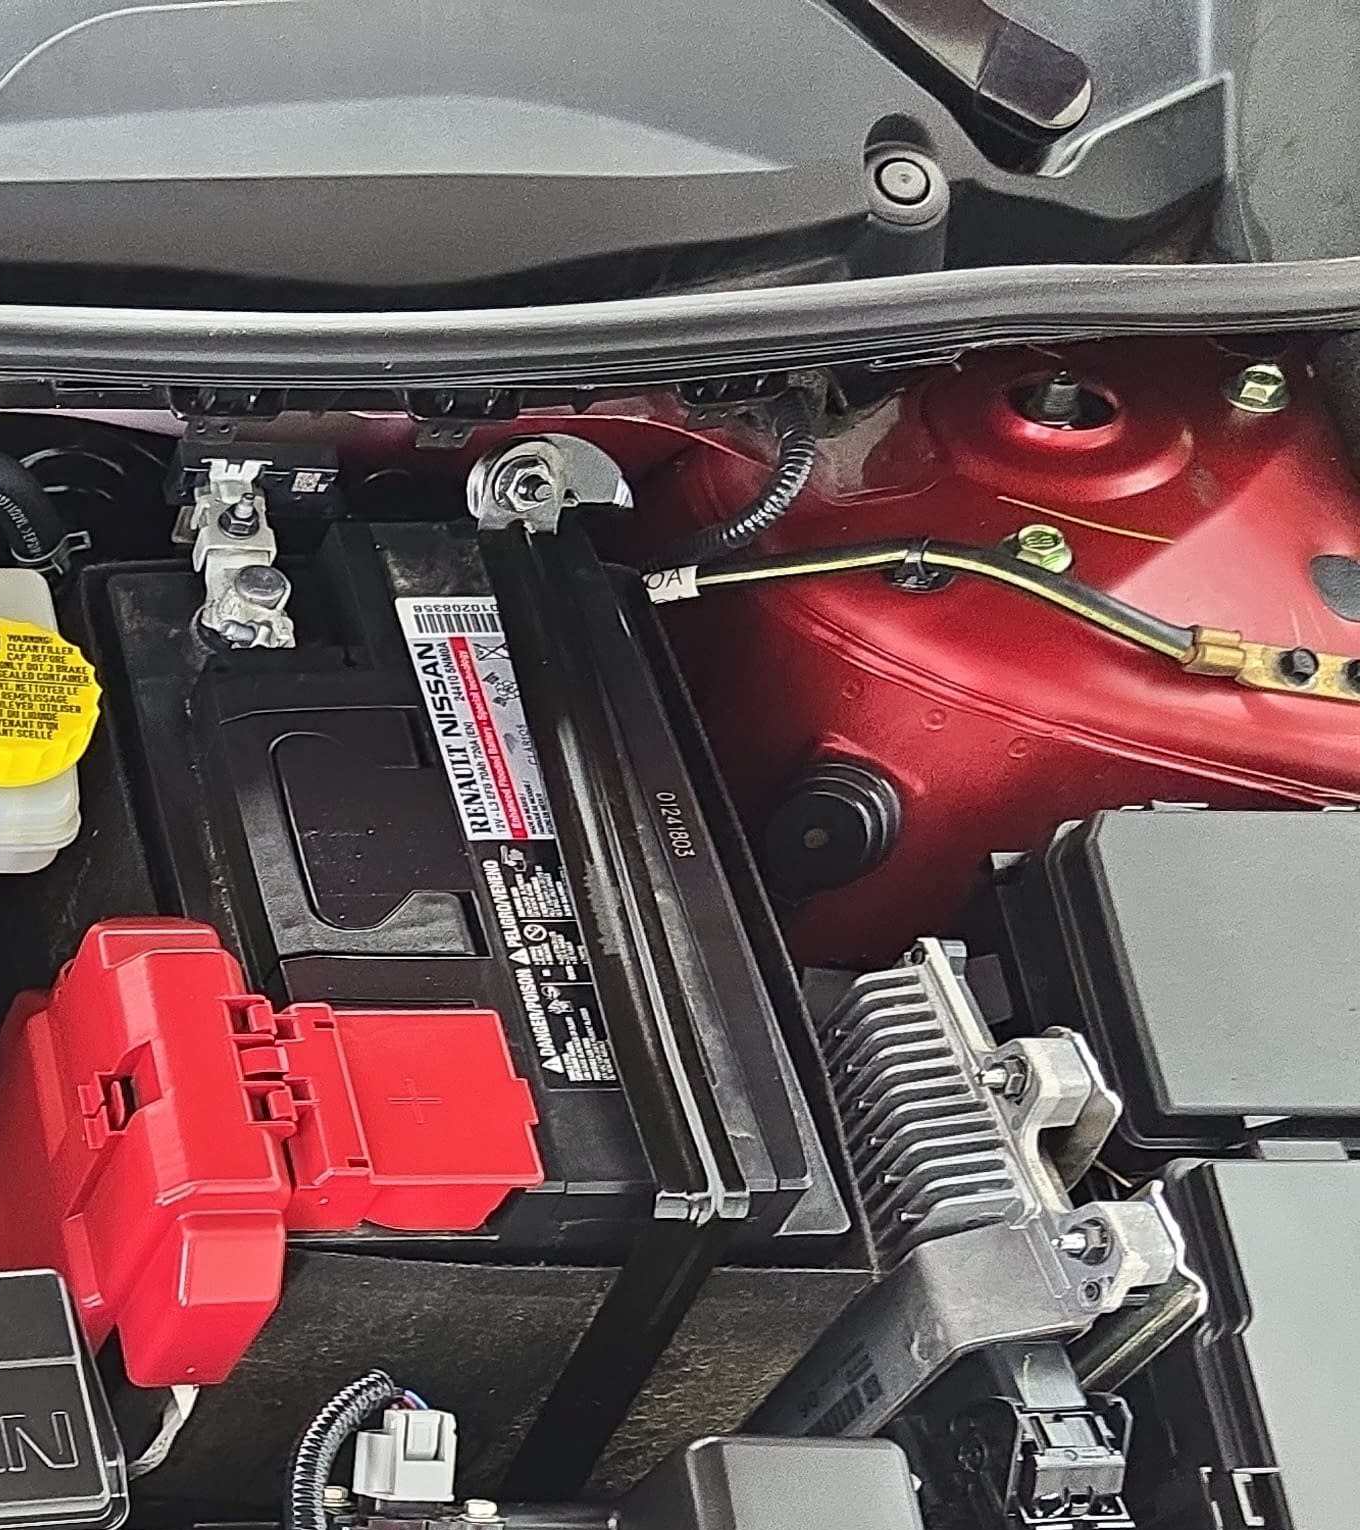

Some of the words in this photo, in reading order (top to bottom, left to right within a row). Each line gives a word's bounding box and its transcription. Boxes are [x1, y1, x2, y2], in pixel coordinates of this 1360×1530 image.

[7, 643, 39, 653] CLEAN
[40, 645, 74, 655] FILLER
[7, 653, 27, 661] CAP
[31, 654, 67, 664] BEFORE
[0, 661, 23, 670] ONLY
[26, 662, 45, 671] DOT
[56, 664, 89, 674] BRAKE
[15, 683, 65, 695] NETTOYER
[67, 687, 79, 695] LE
[417, 642, 460, 737] NISSAN
[451, 674, 467, 702] 24410
[1, 691, 68, 704] REMPLISSAGE
[39, 703, 81, 713] UTILISER
[7, 710, 19, 718] DU
[22, 711, 58, 721] LIQUIDE
[450, 744, 492, 835] RENAULT
[656, 792, 696, 857] 01241803
[483, 860, 522, 949] PELIGRO/VENENO
[519, 968, 558, 1055] DANGER/POISON
